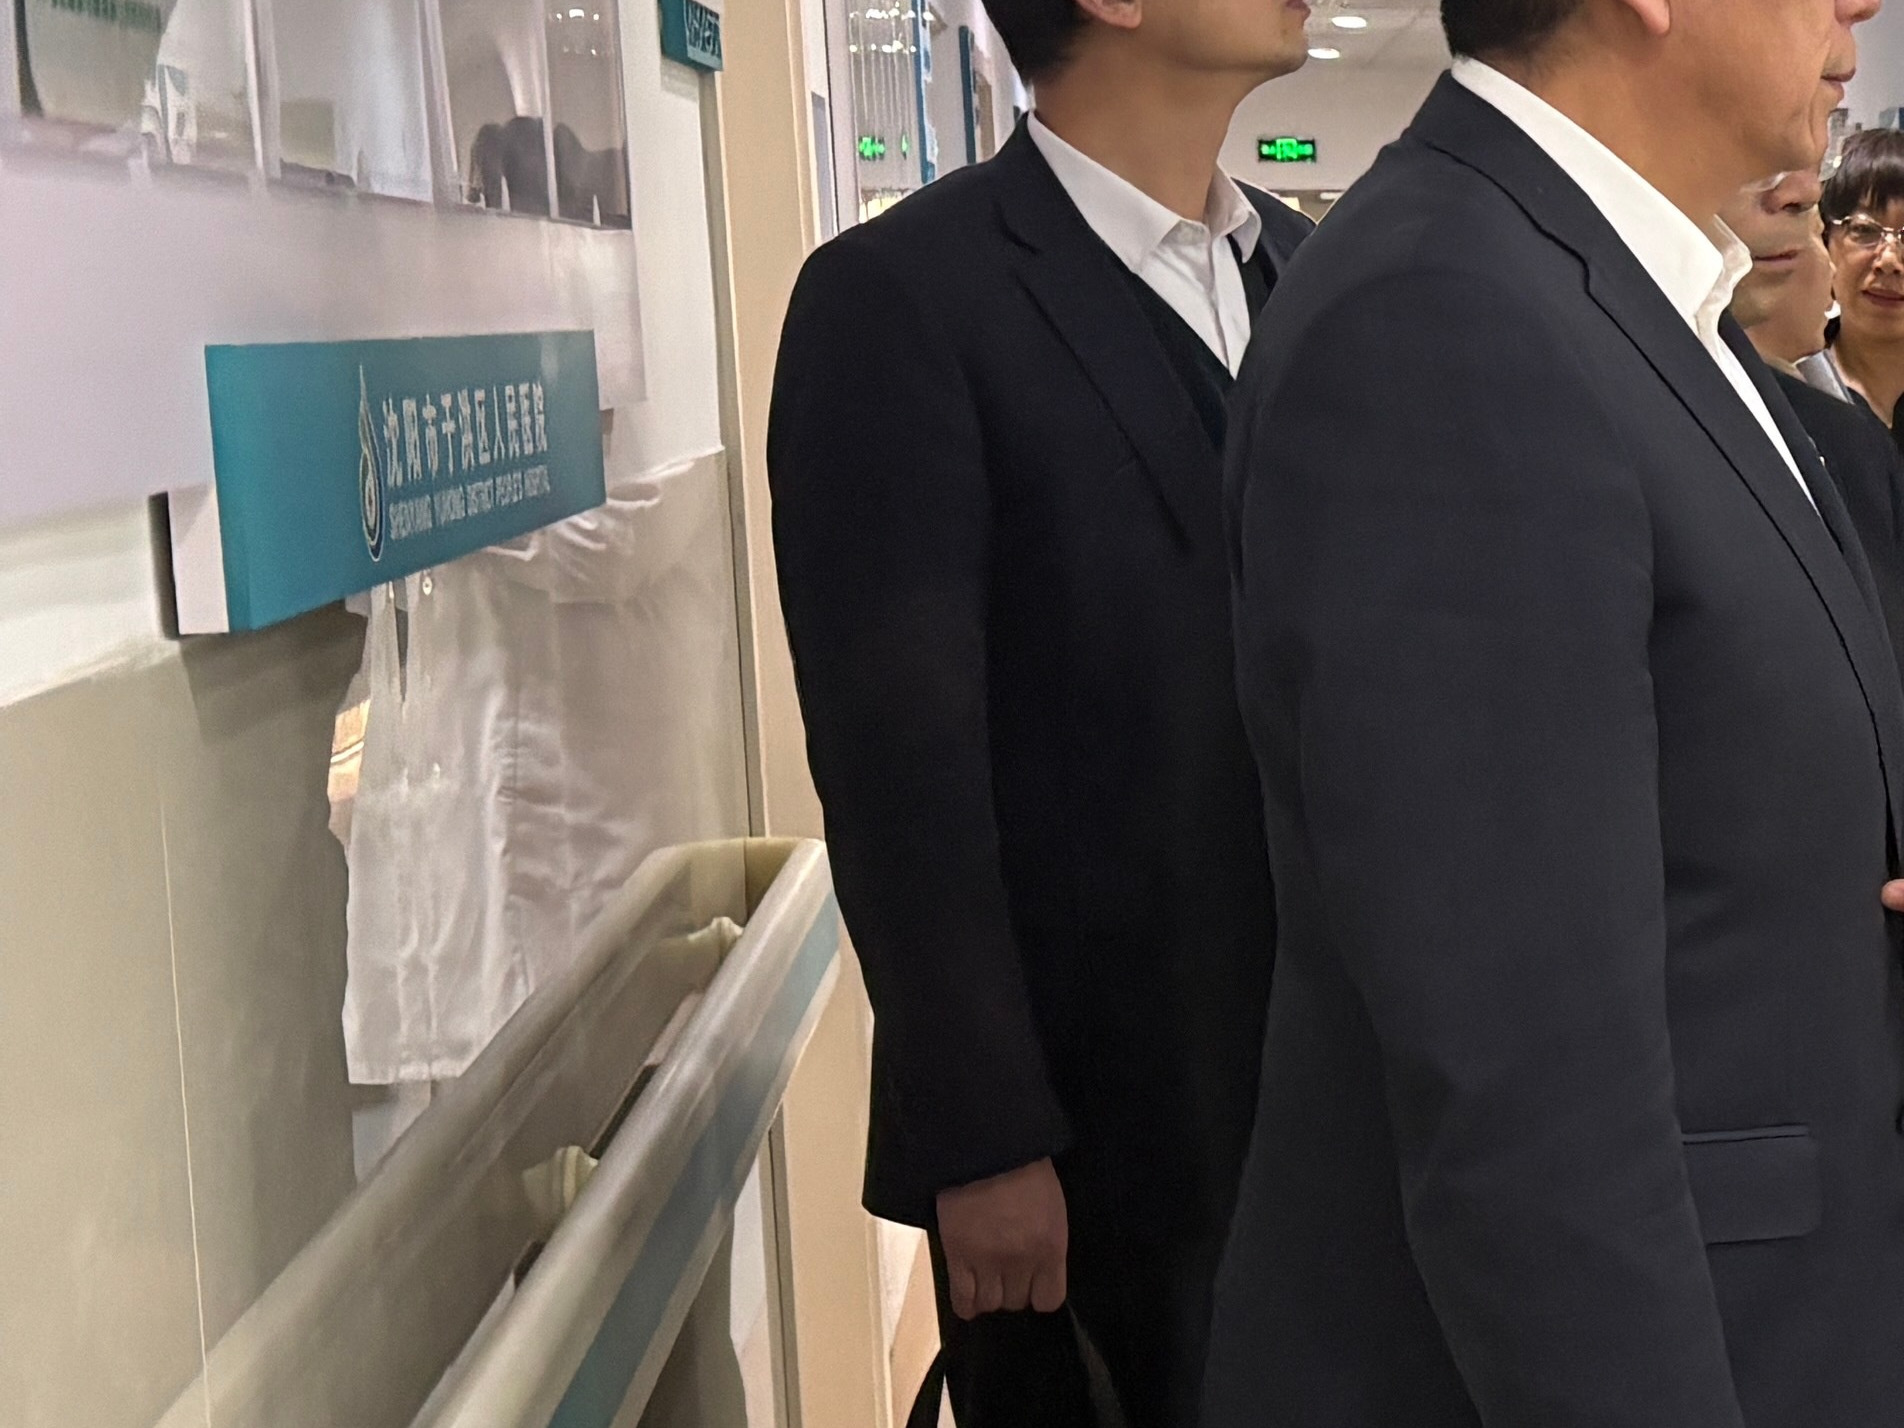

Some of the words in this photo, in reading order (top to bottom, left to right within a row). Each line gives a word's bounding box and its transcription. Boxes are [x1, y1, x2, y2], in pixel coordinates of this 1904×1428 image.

[383, 380, 548, 488] 沈阳市于洪区人民医院
